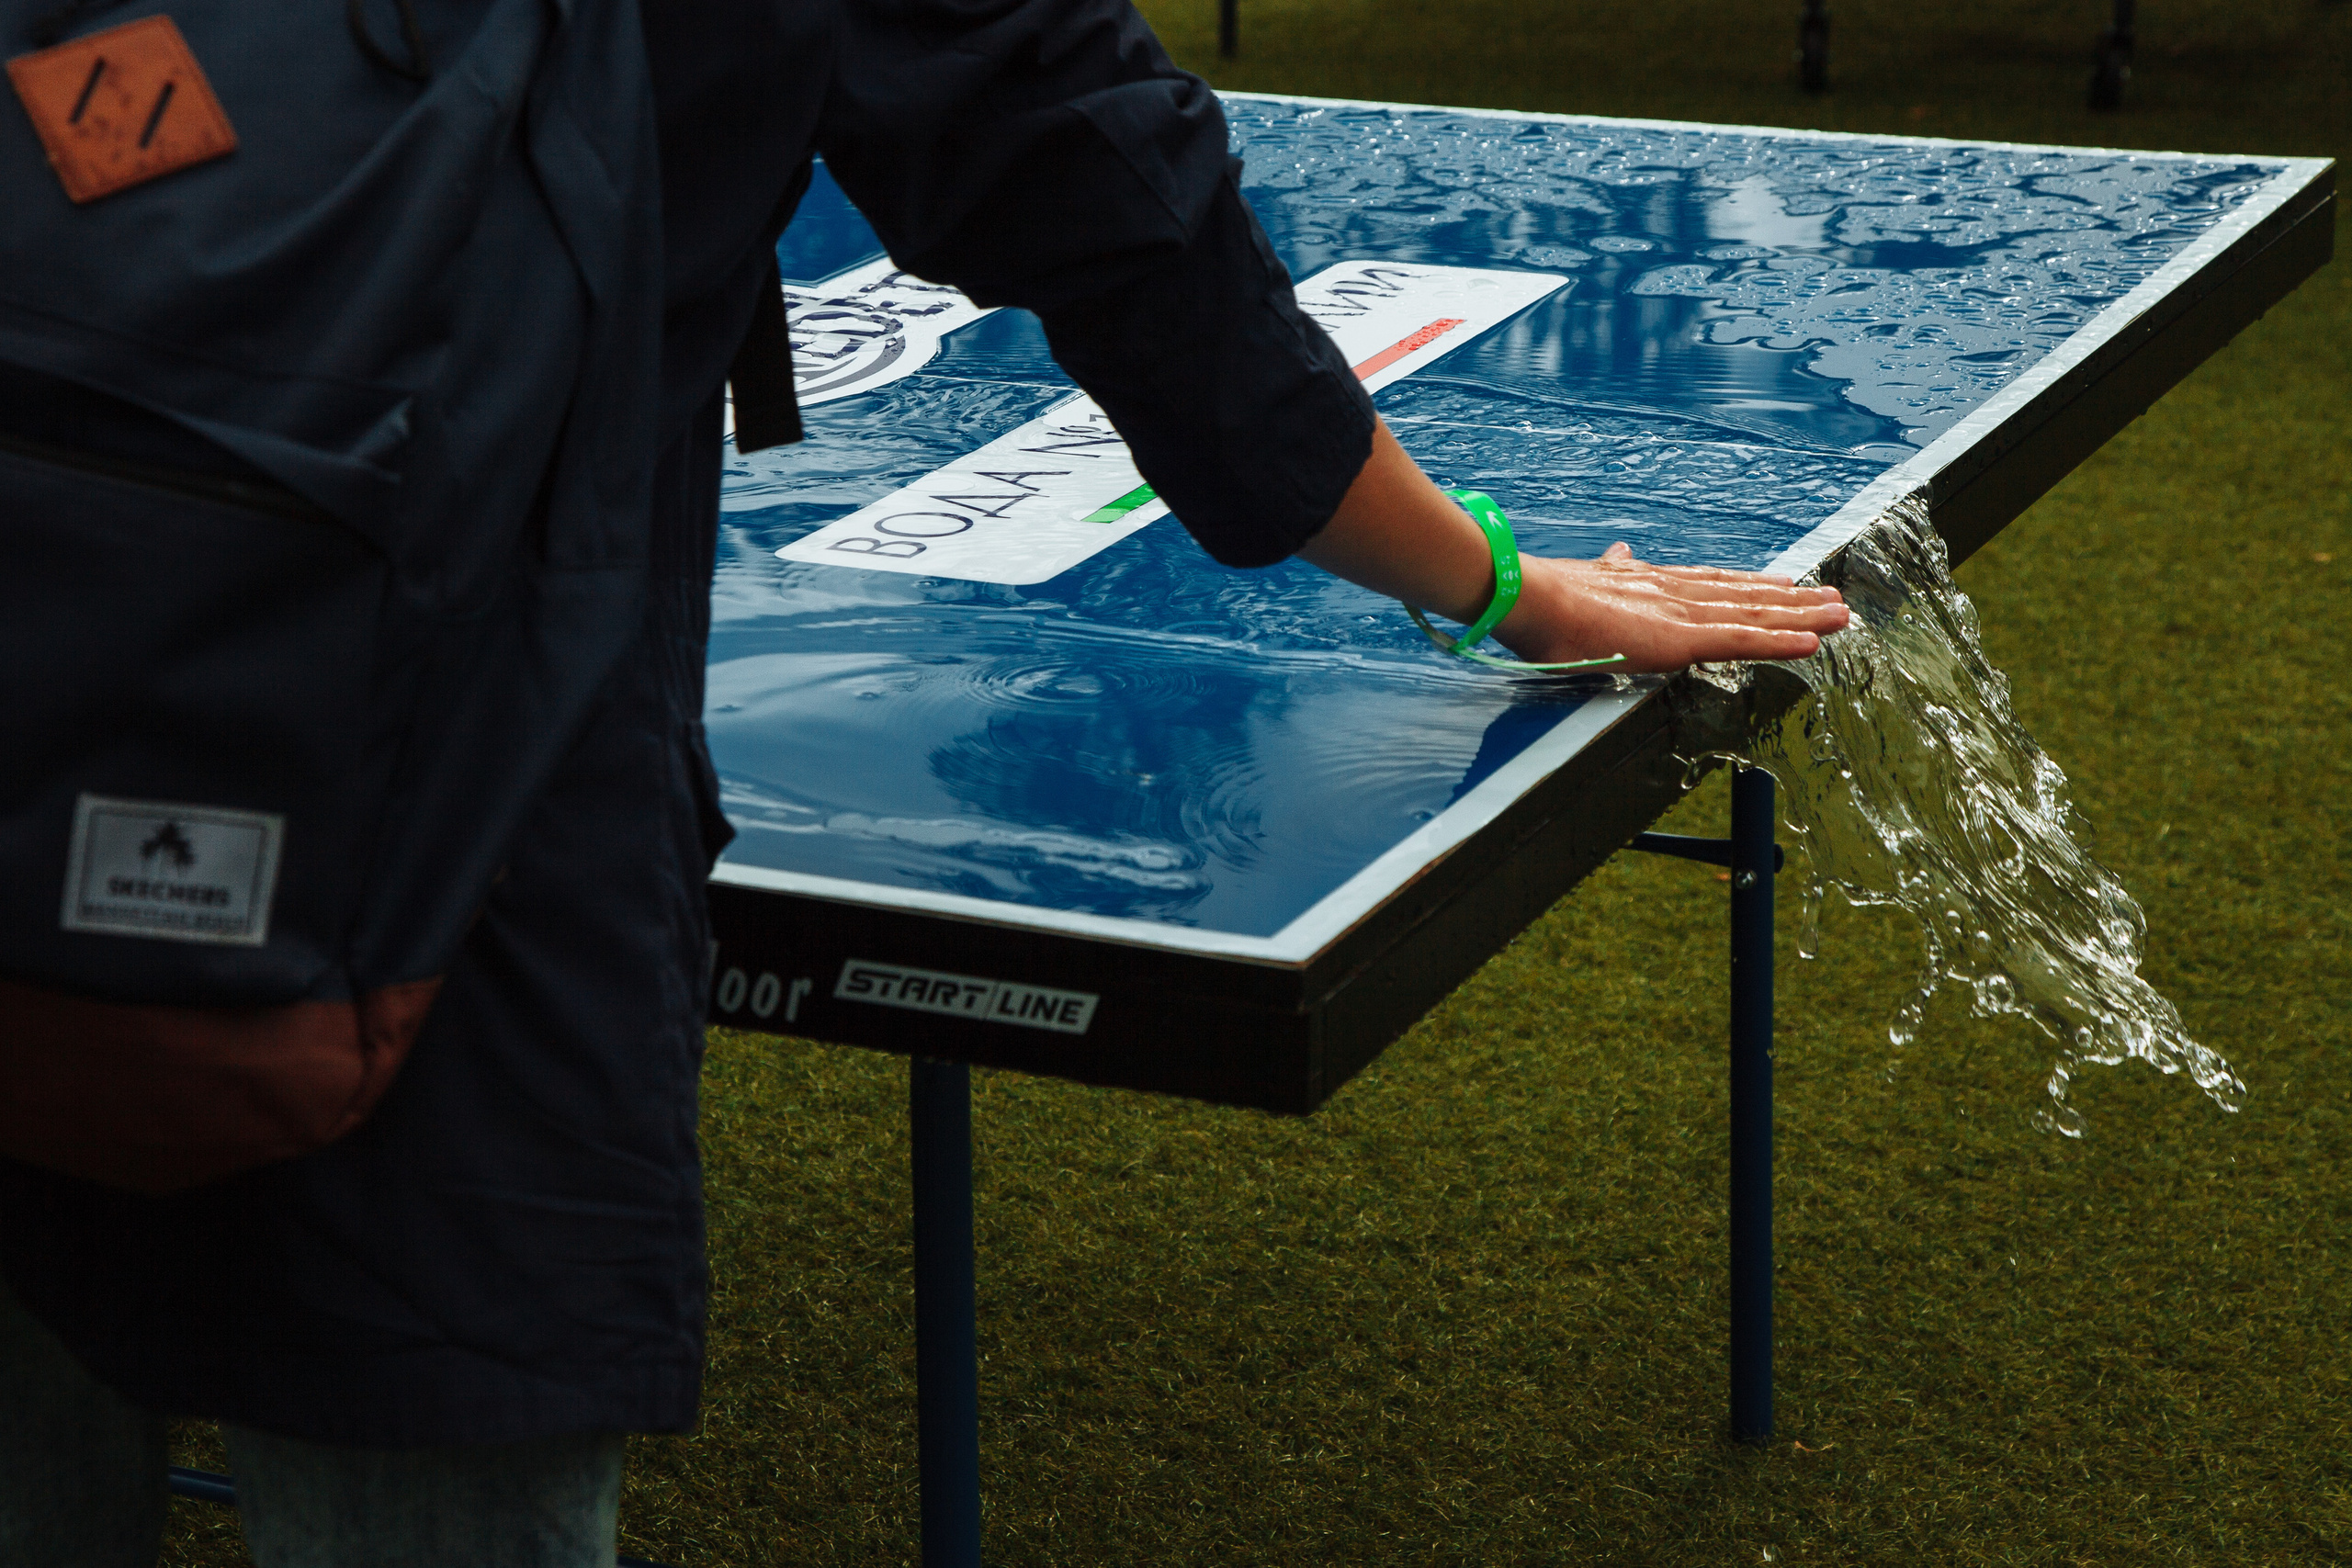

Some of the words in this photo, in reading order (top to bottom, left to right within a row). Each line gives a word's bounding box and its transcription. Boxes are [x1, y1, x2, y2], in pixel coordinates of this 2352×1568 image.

[827, 470, 1073, 558] ВОДА
[709, 942, 814, 1022] oor
[845, 969, 988, 1009] START
[999, 991, 1085, 1026] LINE
